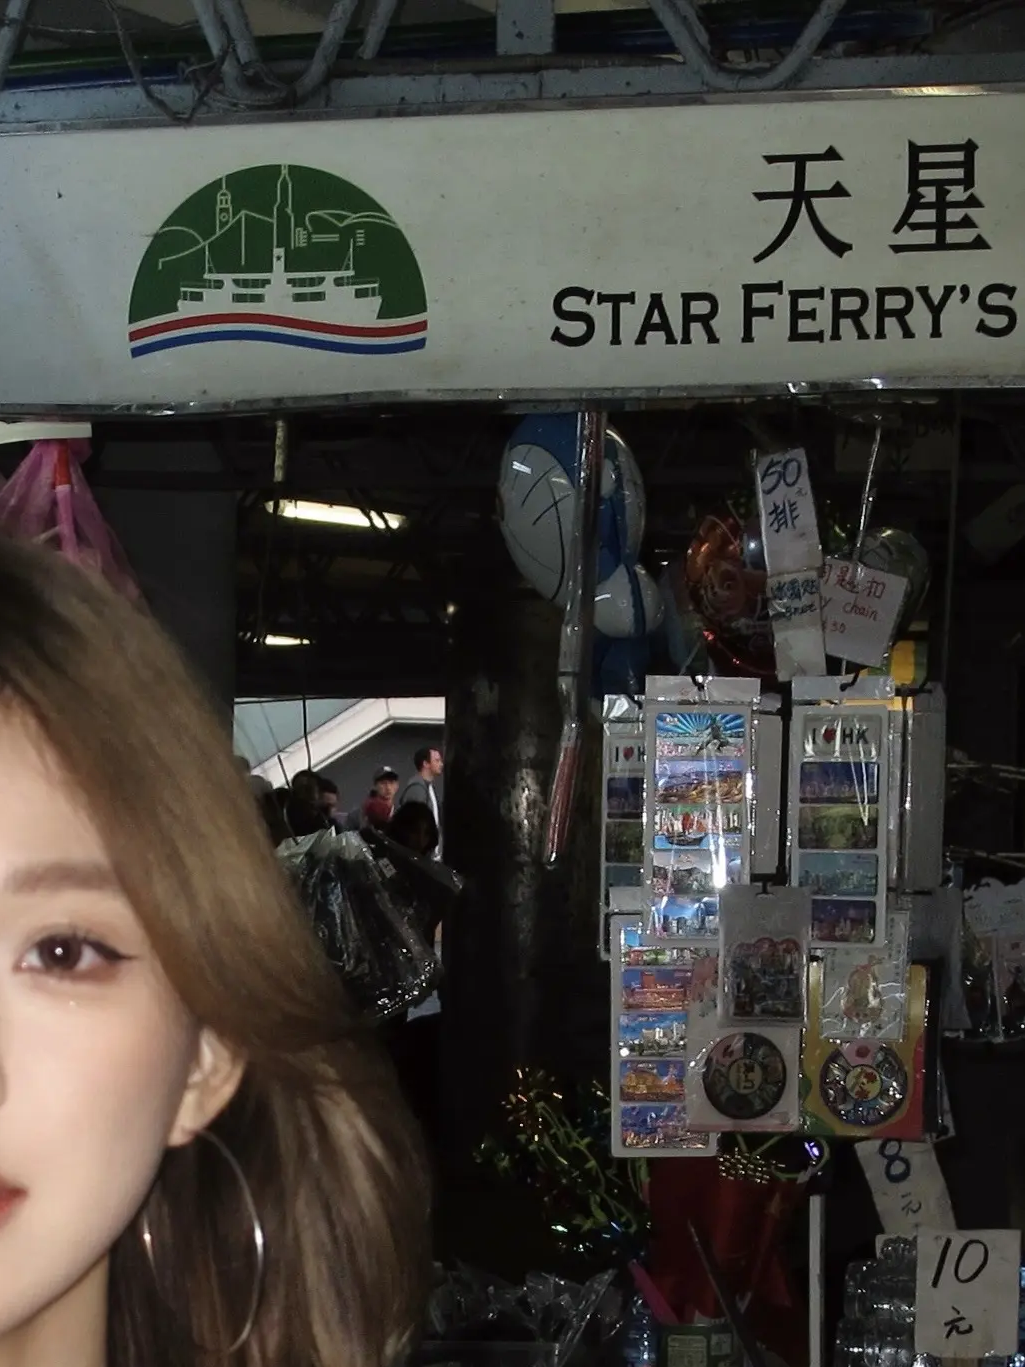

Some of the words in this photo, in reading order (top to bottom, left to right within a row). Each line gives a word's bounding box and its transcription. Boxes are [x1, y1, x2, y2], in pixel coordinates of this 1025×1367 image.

[750, 137, 993, 266] 天星
[549, 284, 720, 350] STAR
[760, 458, 802, 495] 50
[842, 727, 870, 746] HK
[879, 1138, 910, 1184] 8
[931, 1236, 990, 1289] 10
[943, 1305, 974, 1340] 元
